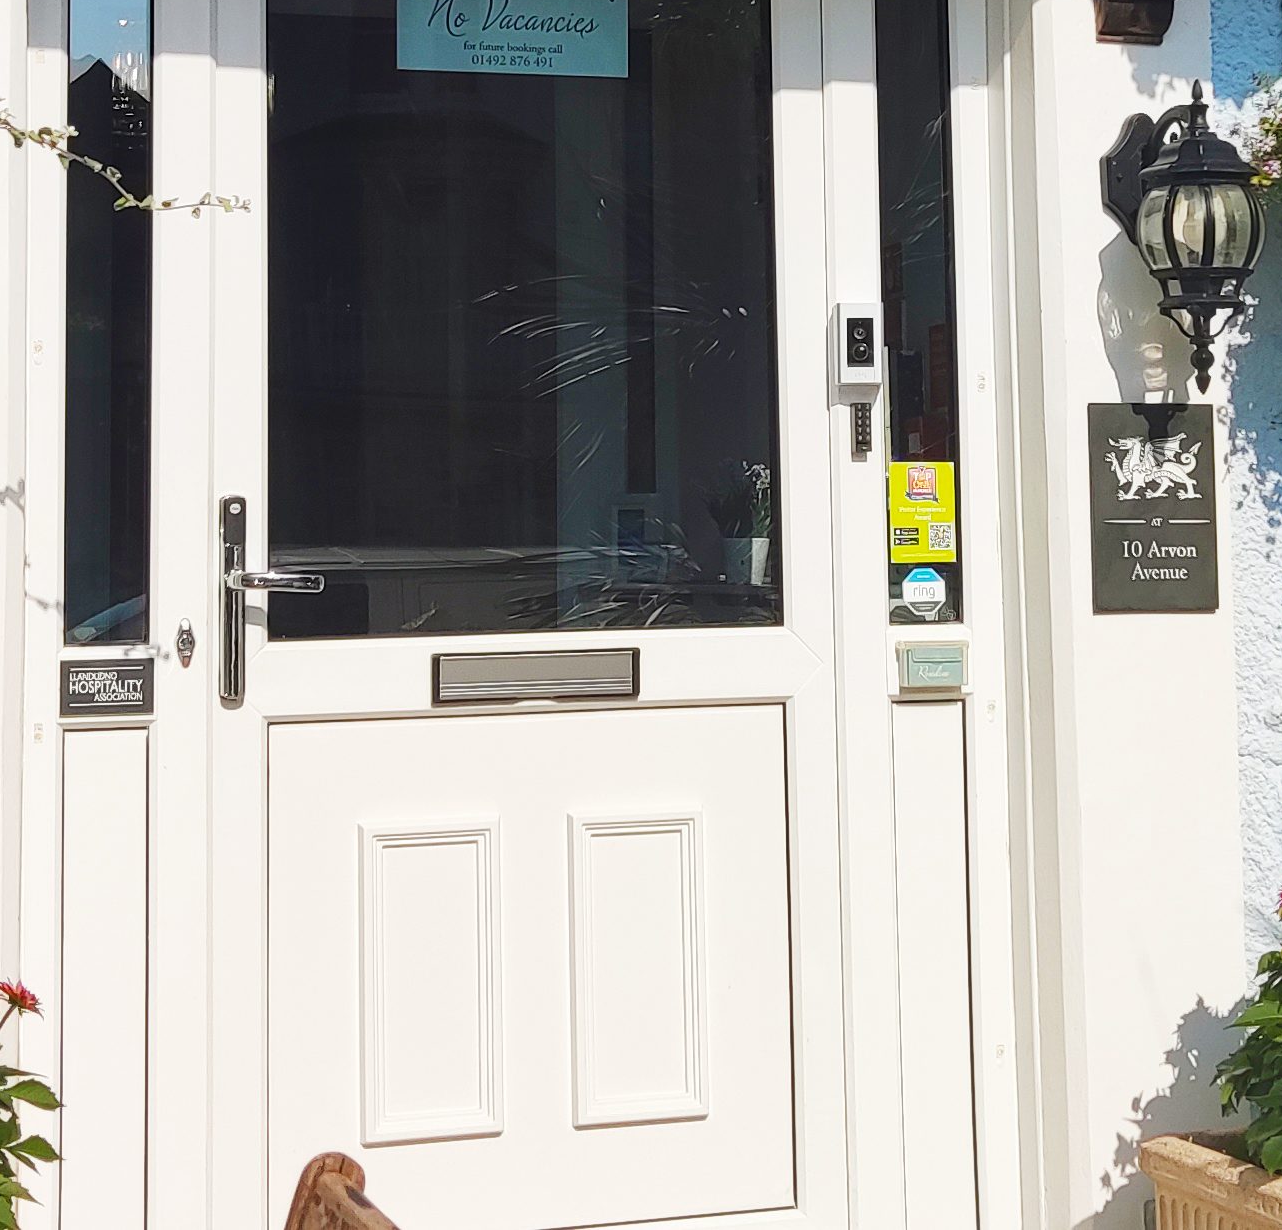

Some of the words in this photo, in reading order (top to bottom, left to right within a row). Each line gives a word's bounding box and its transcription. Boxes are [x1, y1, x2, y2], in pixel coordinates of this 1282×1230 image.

[463, 41, 477, 51] for
[479, 42, 505, 52] future
[507, 43, 546, 55] bookings
[548, 44, 563, 54] call
[471, 55, 506, 66] 01492
[509, 55, 531, 67] 876
[533, 56, 553, 68] 491
[1121, 541, 1143, 558] 10
[1147, 541, 1198, 558] Arvon
[1131, 561, 1189, 581] Avenue
[913, 585, 936, 599] ring
[69, 679, 143, 694] HOSPITALITY
[93, 691, 143, 702] ASSOCIATION
